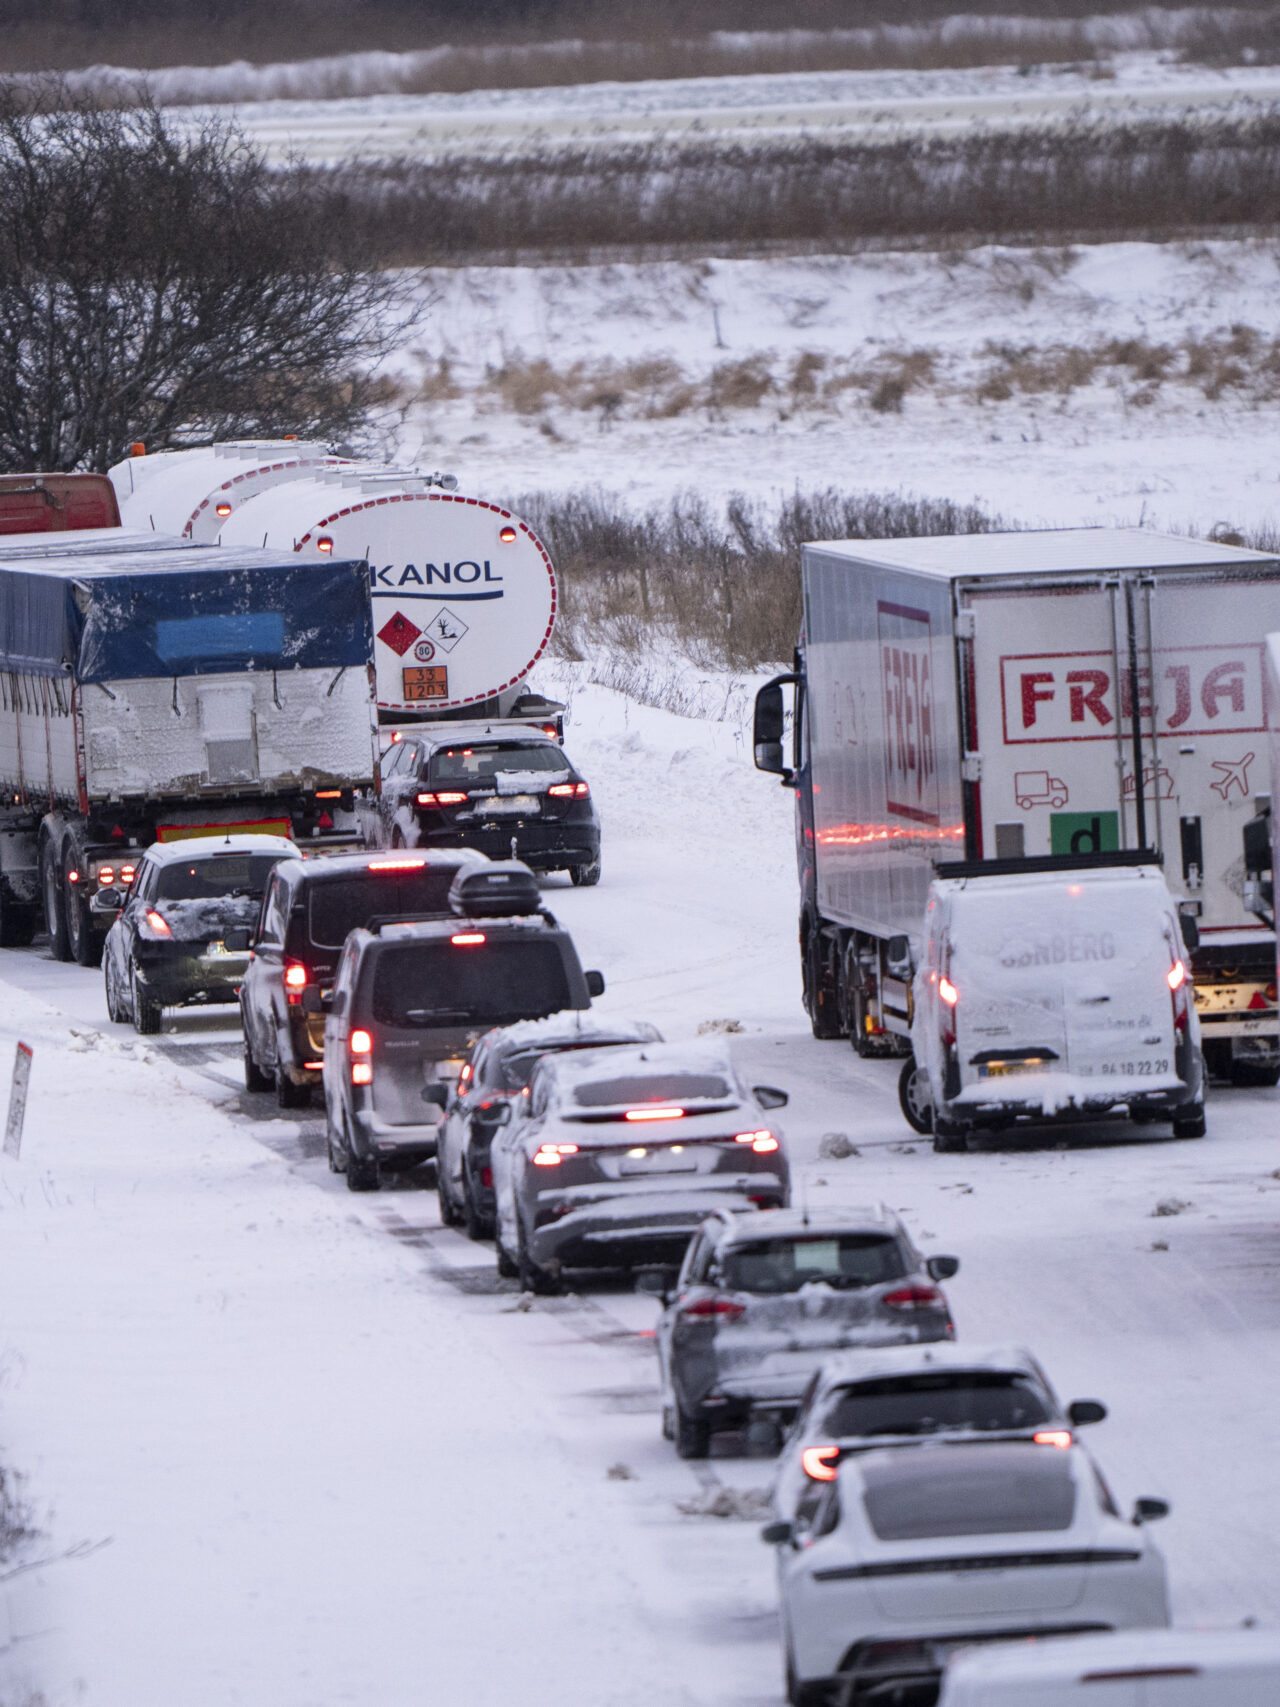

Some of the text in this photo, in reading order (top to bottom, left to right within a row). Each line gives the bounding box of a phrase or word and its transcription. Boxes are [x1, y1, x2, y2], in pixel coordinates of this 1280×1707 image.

[369, 560, 503, 587] KANOL
[417, 669, 435, 681] 33
[408, 684, 446, 698] 1203
[1020, 660, 1246, 729] FREJA
[883, 646, 934, 801] FREJA
[1138, 1060, 1152, 1075] 22
[1155, 1059, 1169, 1074] 29
